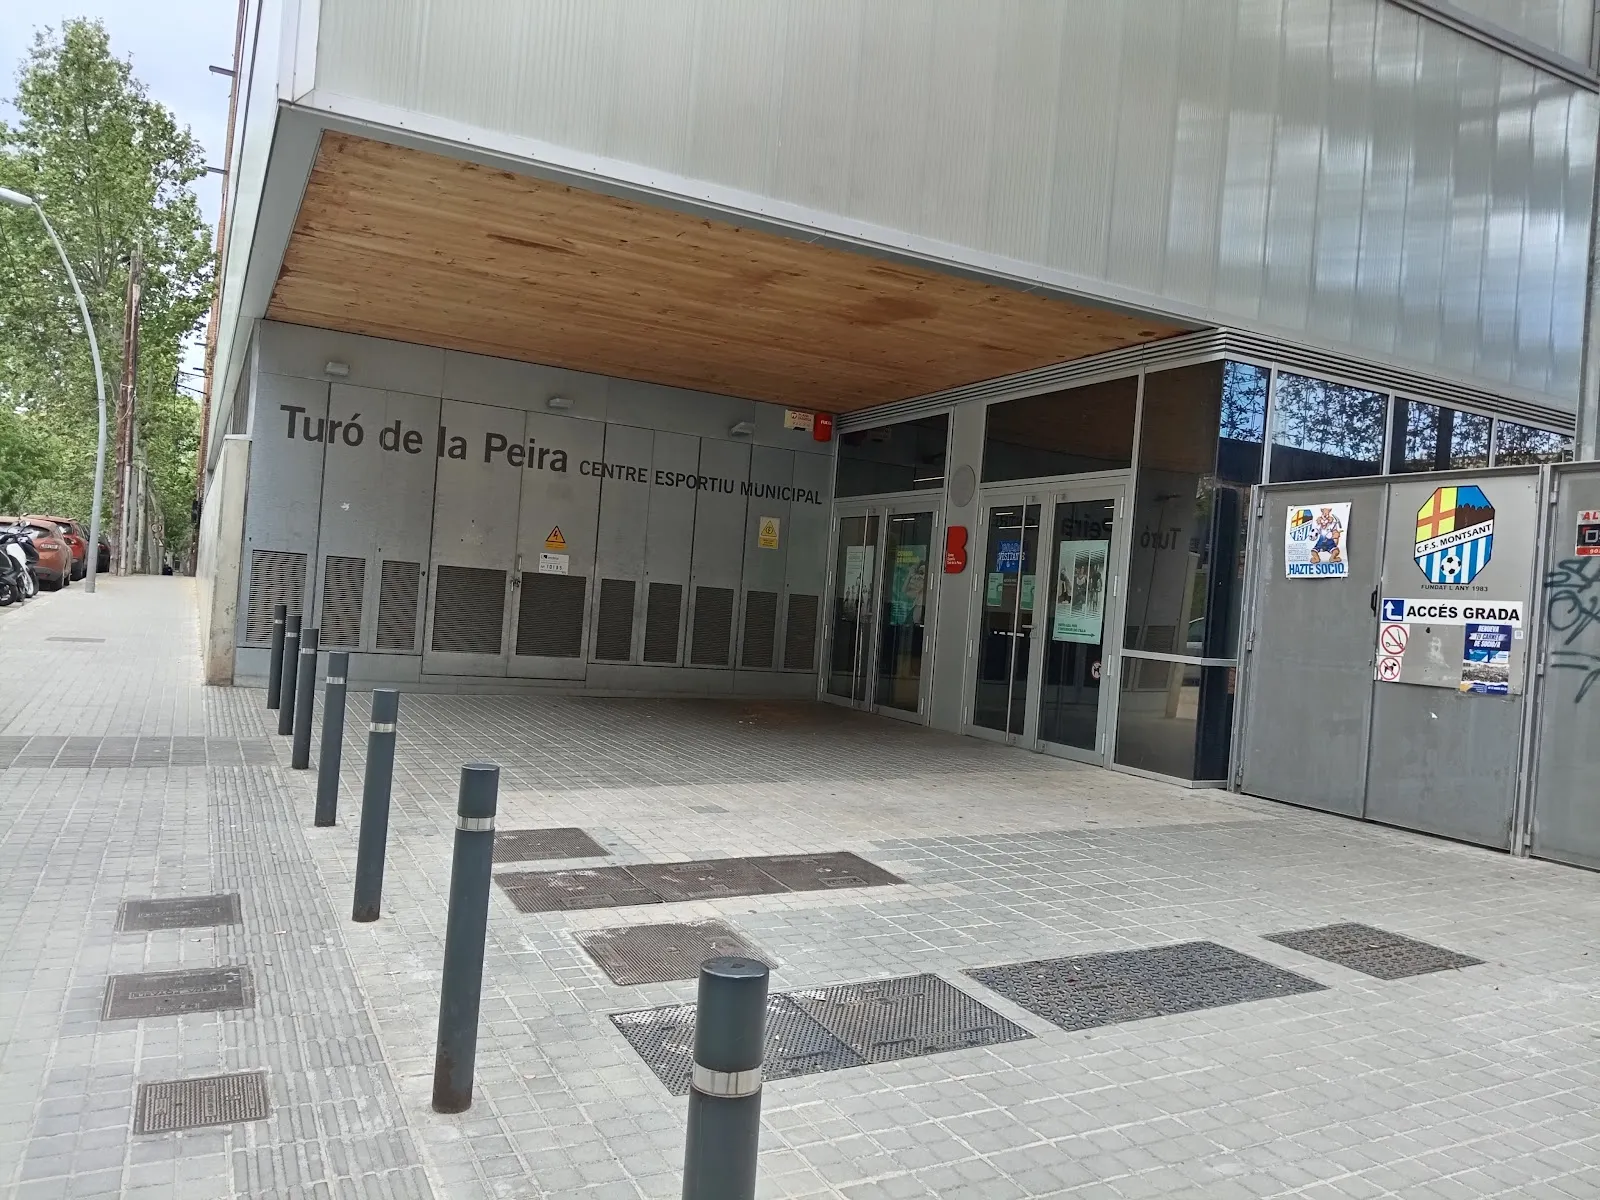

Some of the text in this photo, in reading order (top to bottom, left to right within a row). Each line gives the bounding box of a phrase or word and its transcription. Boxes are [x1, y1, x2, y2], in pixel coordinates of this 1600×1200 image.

[280, 404, 568, 473] Turó de la Peira
[579, 460, 823, 505] CENTRE ESPORTIU MUNICIPAL
[1416, 523, 1491, 554] C.F.S. MONTSANT
[1289, 562, 1344, 575] HAZTE SOCIO
[1407, 603, 1520, 621] ACCÉS GRADA
